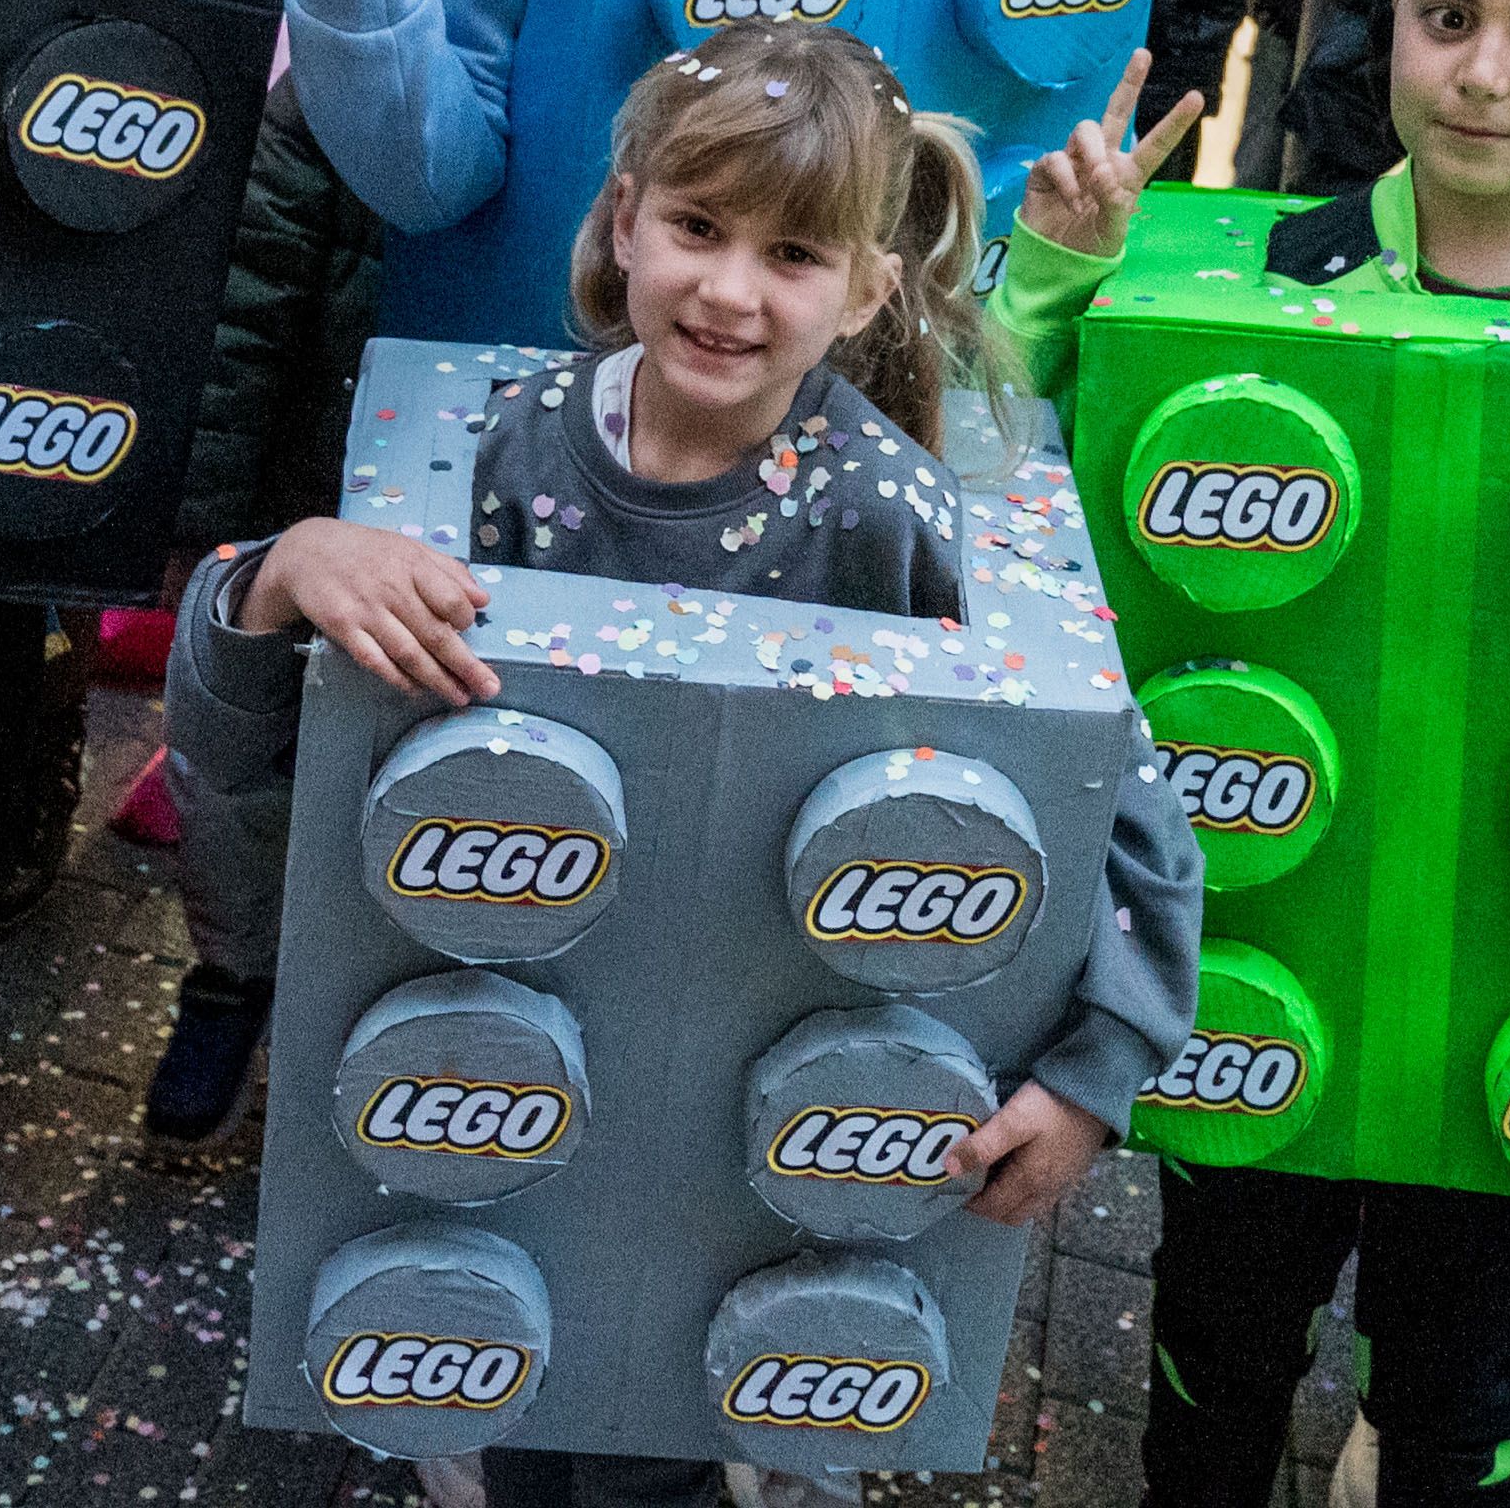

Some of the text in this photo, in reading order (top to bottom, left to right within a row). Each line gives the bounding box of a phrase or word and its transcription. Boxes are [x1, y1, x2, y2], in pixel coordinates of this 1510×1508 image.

[28, 81, 198, 172] LEGO
[1146, 468, 1329, 545] LEGO
[397, 825, 600, 899] LEGO
[815, 866, 1018, 938] LEGO
[1140, 1036, 1299, 1109] EGO
[366, 1081, 562, 1152] LEGO
[777, 1111, 969, 1180] LEGO
[332, 1336, 522, 1402] LEGO
[732, 1358, 921, 1426] LEGO
